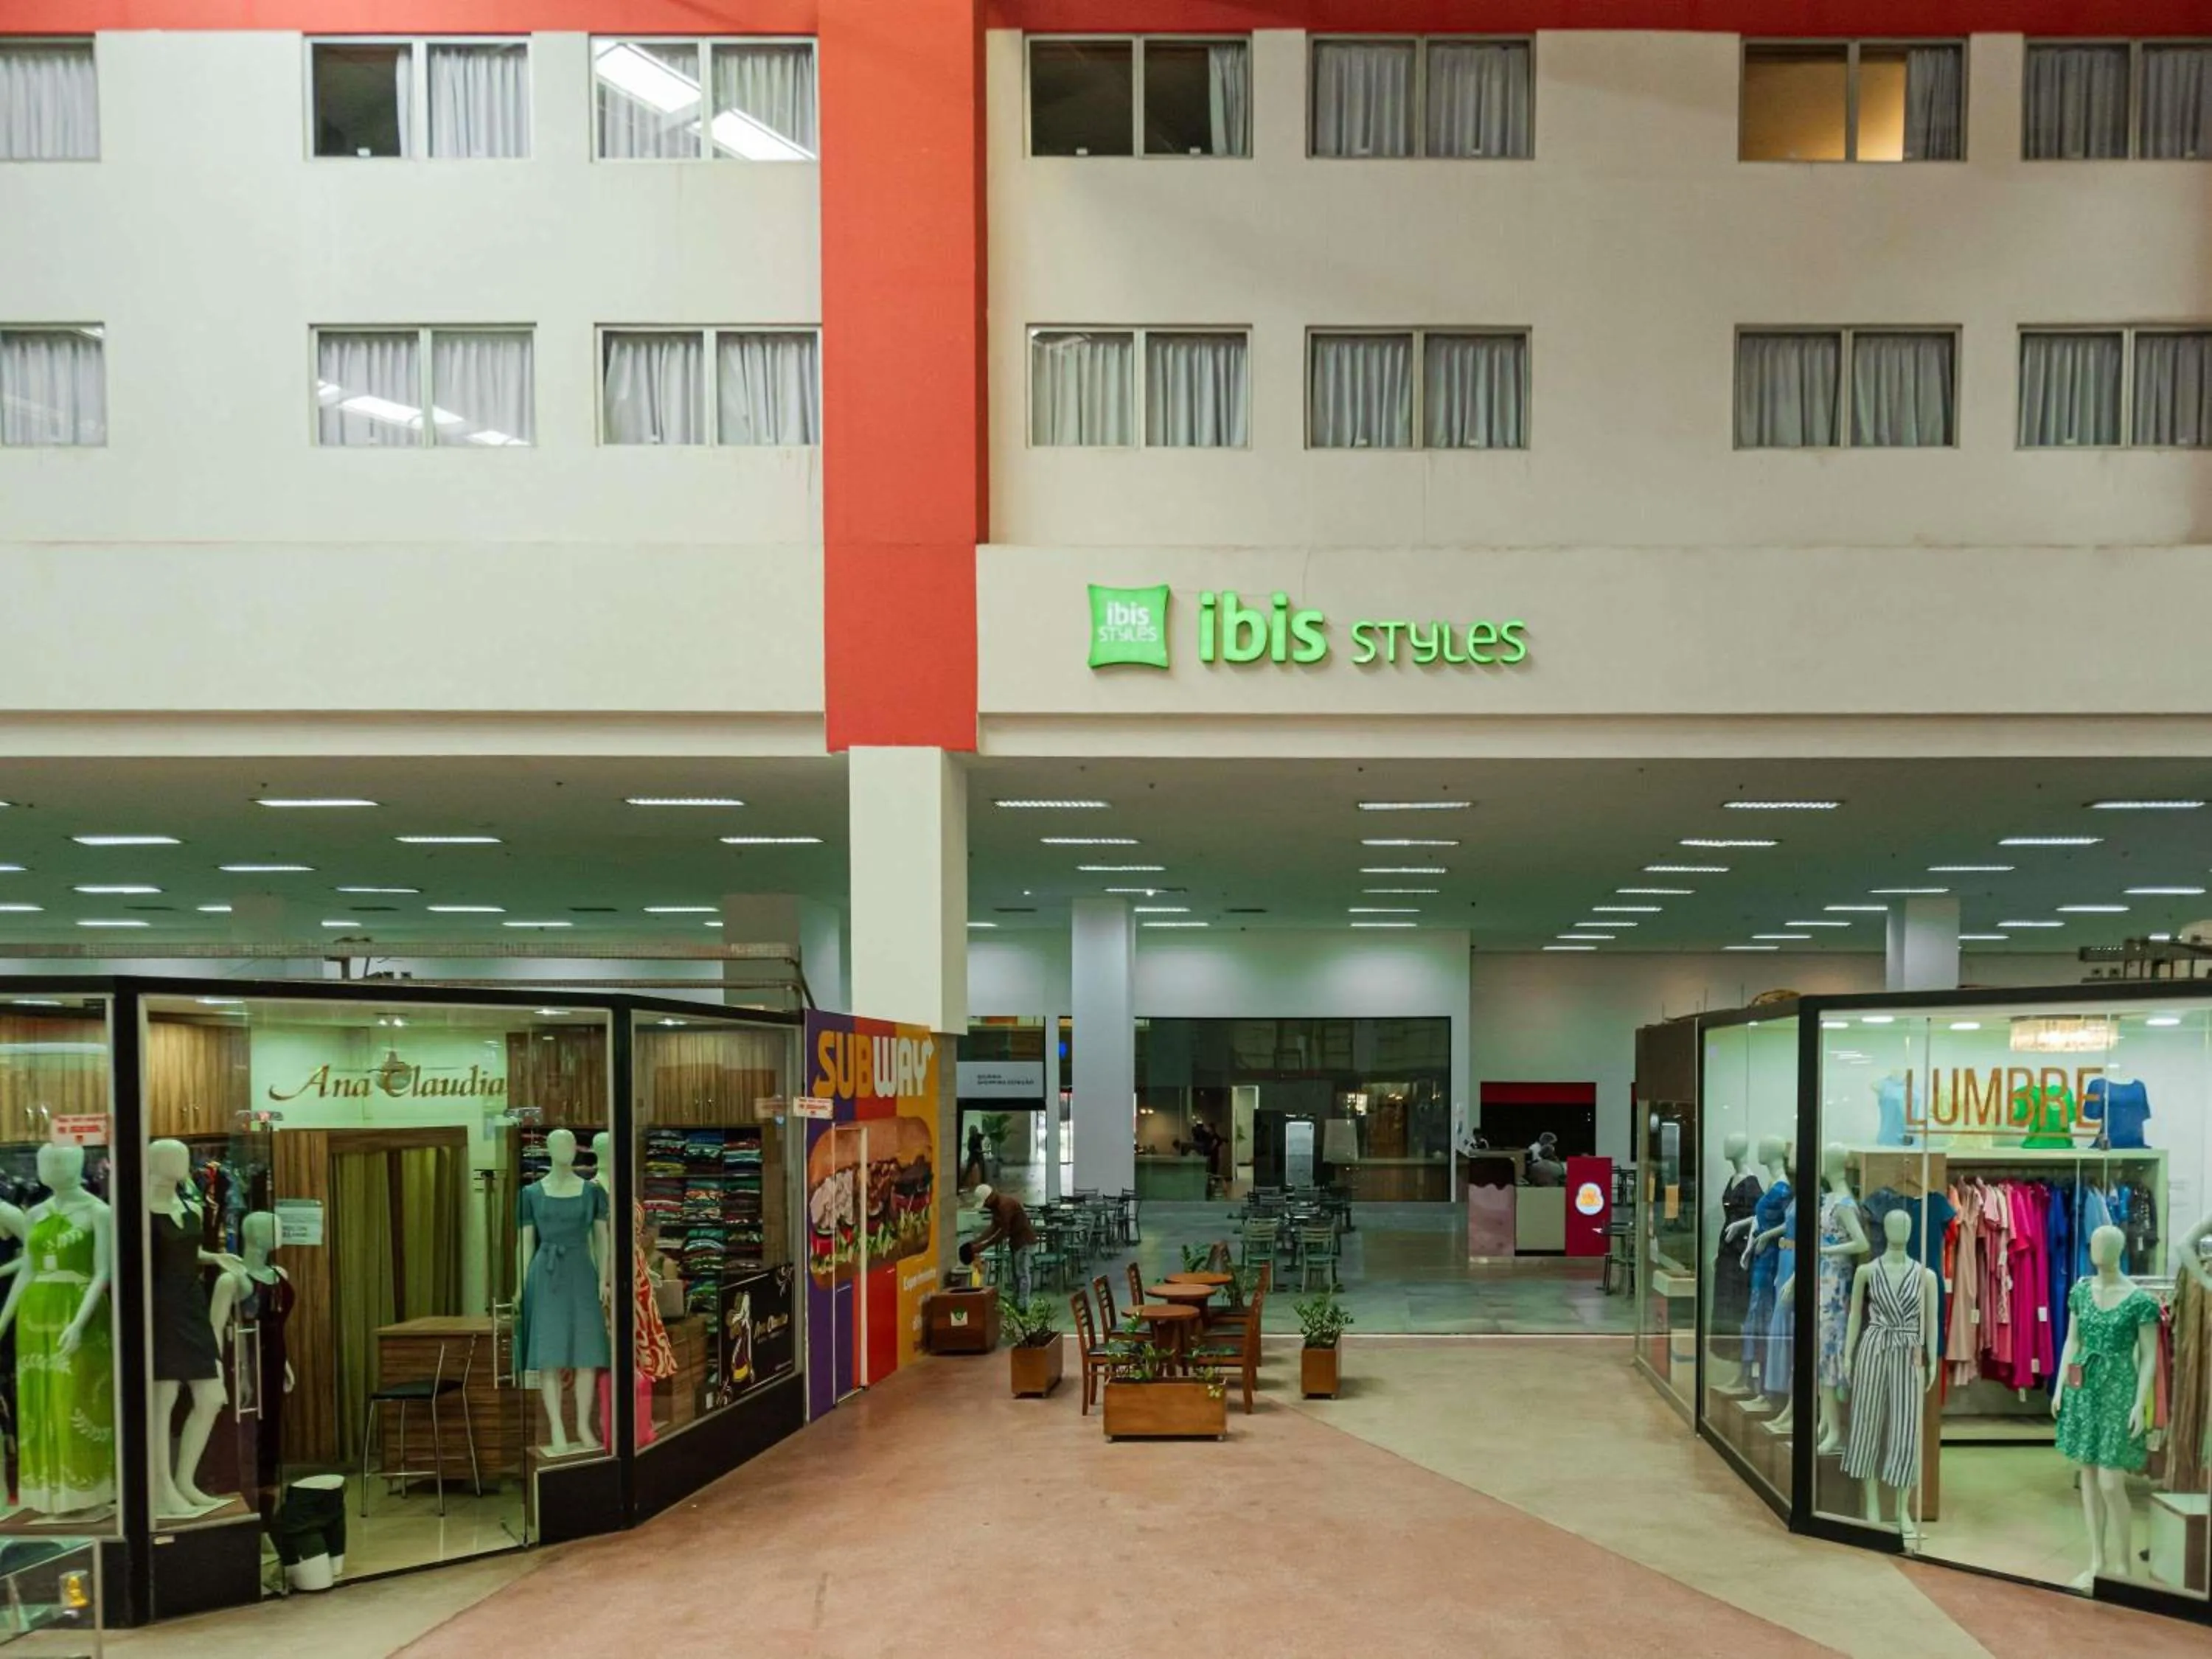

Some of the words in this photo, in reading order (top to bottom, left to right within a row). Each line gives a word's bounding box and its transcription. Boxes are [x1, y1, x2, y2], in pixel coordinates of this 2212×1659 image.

[1107, 600, 1150, 626] ibis
[1198, 591, 1326, 662] ibis
[268, 1064, 372, 1101] Ana
[382, 1065, 508, 1098] Claudia
[812, 1030, 935, 1099] SUBWAY
[1905, 1067, 2104, 1128] LUMBRE
